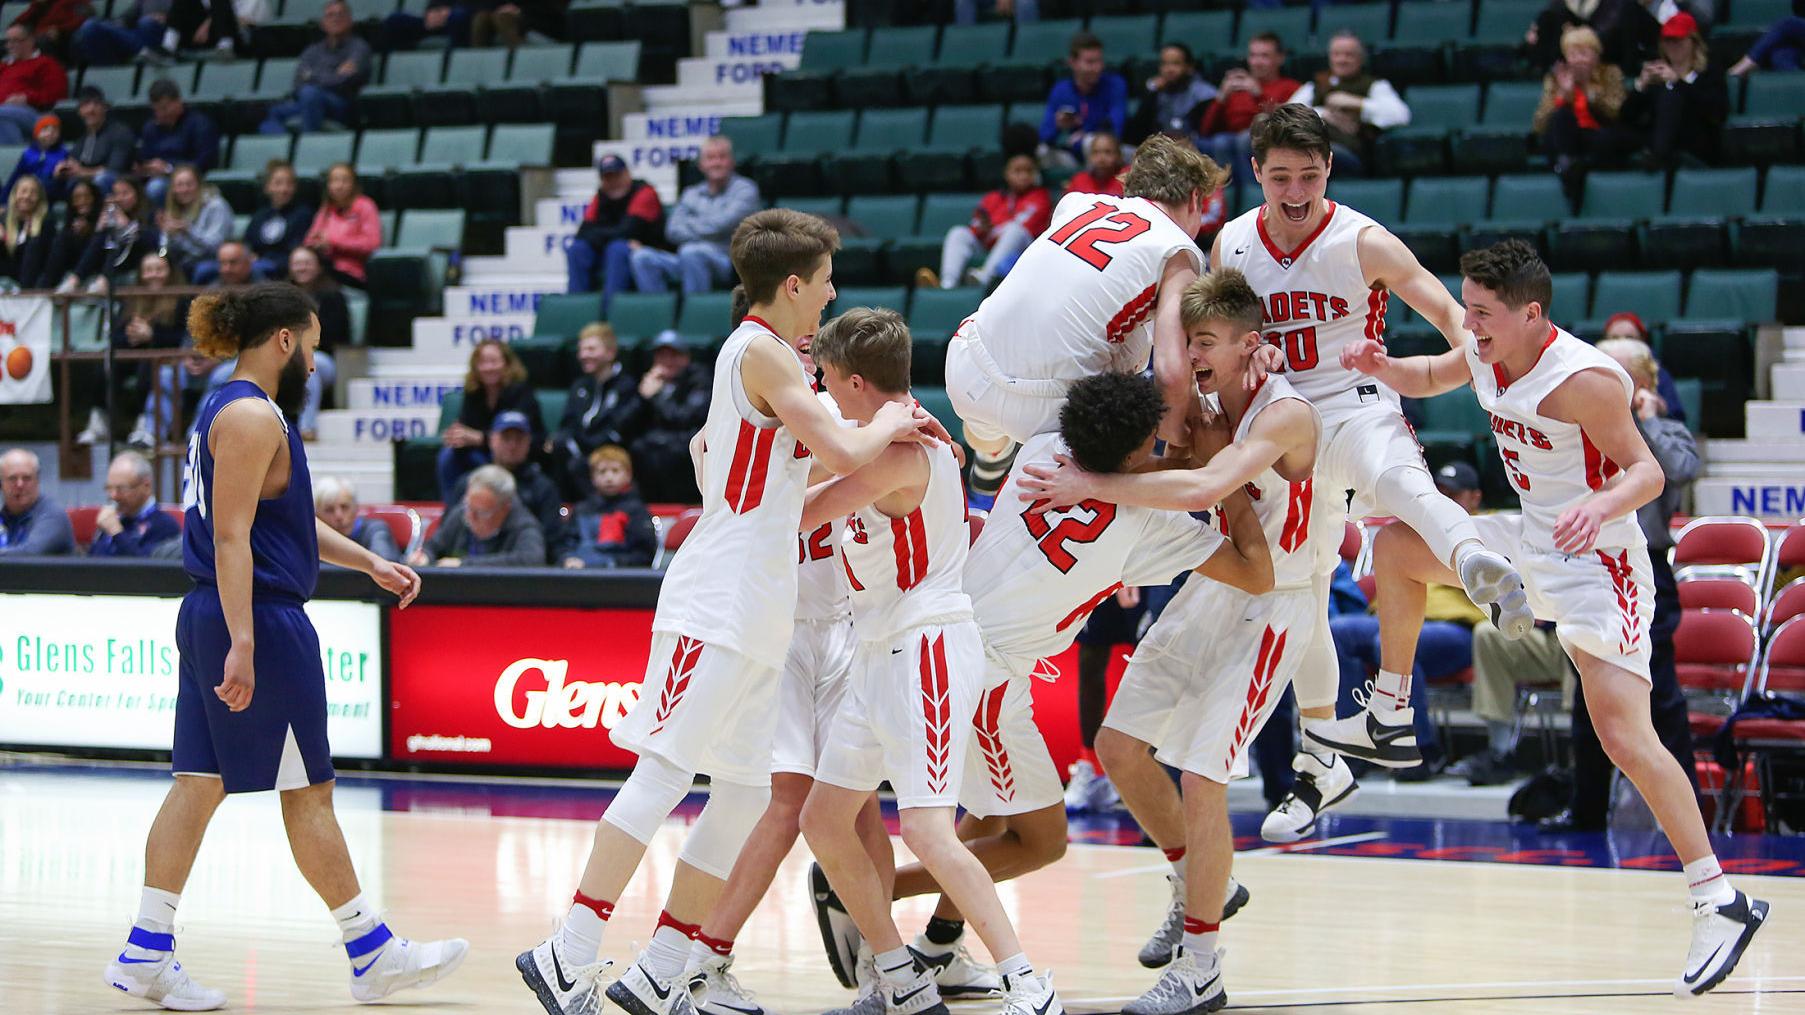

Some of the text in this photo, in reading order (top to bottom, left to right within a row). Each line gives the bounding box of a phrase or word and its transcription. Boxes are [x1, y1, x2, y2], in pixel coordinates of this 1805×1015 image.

[1048, 201, 1151, 272] 12
[1263, 325, 1320, 373] 10
[17, 635, 368, 683] Glens Falls ter
[494, 657, 643, 730] Glens
